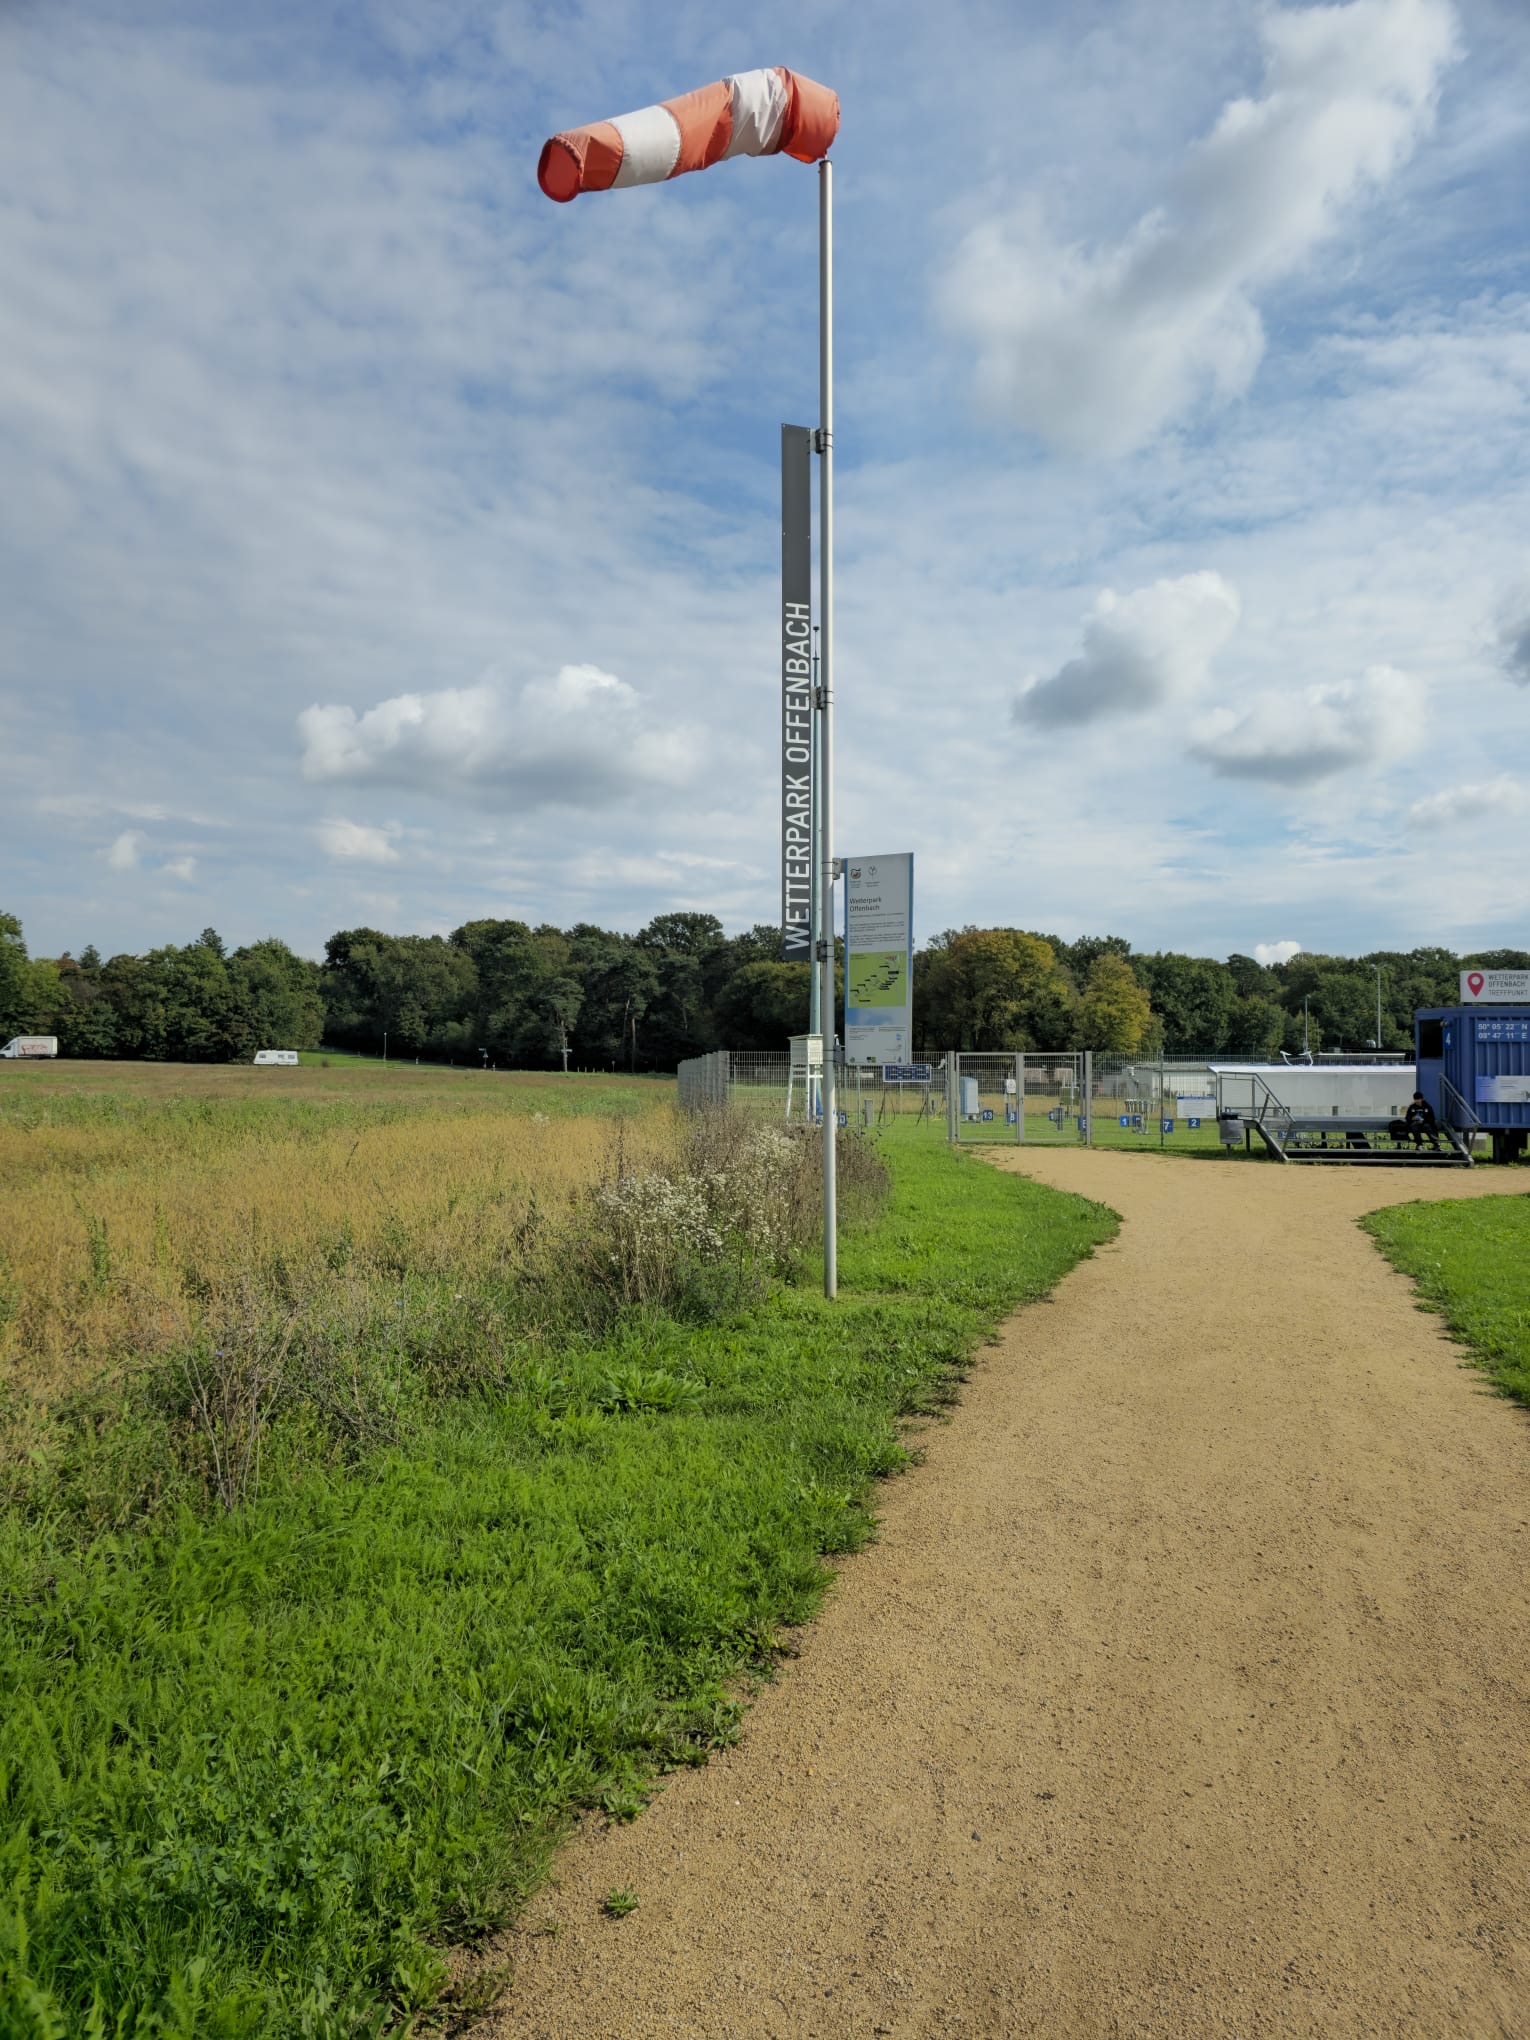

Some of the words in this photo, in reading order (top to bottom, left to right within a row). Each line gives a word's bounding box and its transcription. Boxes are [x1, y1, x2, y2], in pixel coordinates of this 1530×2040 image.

[785, 602, 810, 763] OFFENBACH
[785, 774, 810, 950] WETTERPARK
[849, 896, 882, 906] Wetterpark
[849, 905, 880, 913] Offenbach
[1445, 1032, 1452, 1046] 4
[1191, 1118, 1197, 1127] 2
